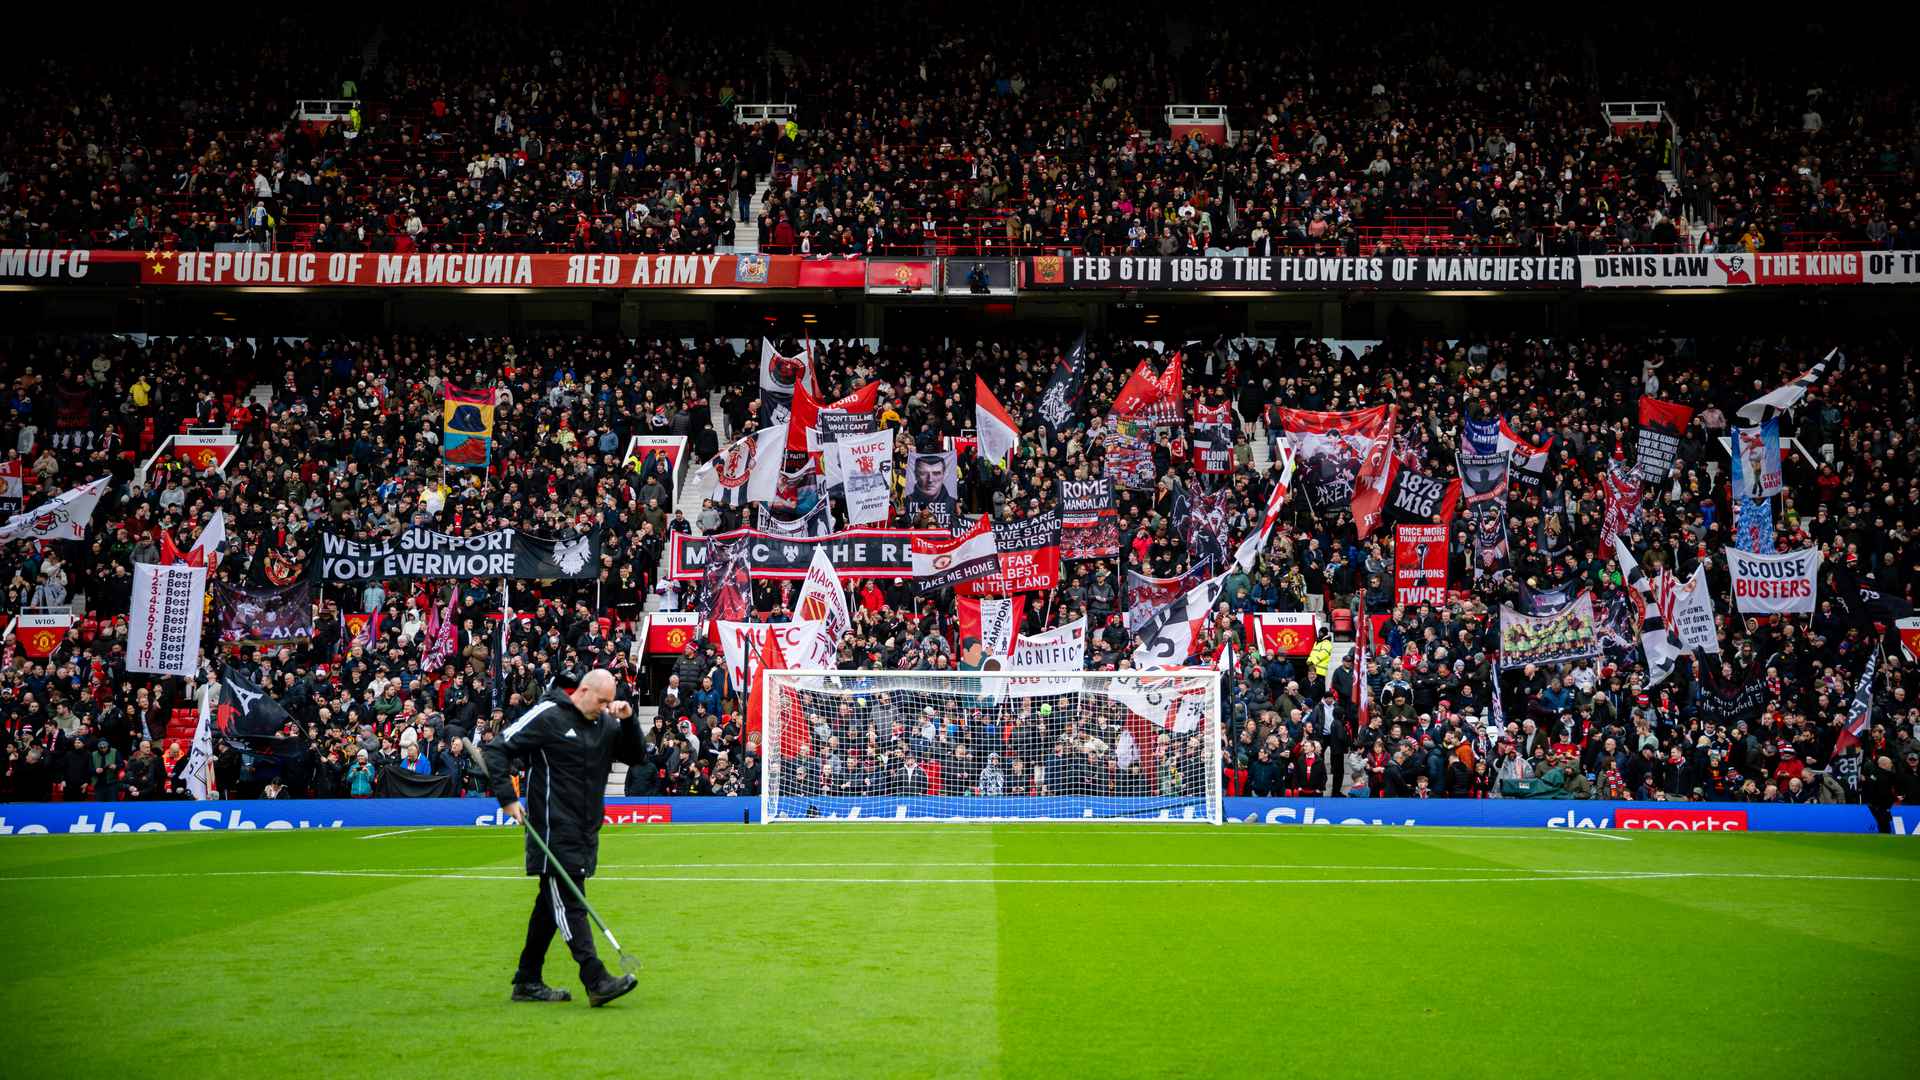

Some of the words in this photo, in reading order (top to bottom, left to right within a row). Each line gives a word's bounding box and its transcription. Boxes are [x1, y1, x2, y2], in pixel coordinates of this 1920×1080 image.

[0, 249, 89, 278] MUFC
[328, 253, 364, 282] OF
[1073, 257, 1111, 281] FEB
[1120, 257, 1161, 281] 6TH
[1171, 257, 1222, 281] 1958
[1232, 257, 1272, 281] THE
[1280, 257, 1383, 281] FLOWERS
[1392, 257, 1418, 281] OF
[1427, 256, 1576, 281] MANCHESTER
[1595, 256, 1657, 278] DENIS
[1663, 256, 1709, 278] LAW
[1760, 254, 1800, 277] THE
[1806, 254, 1857, 276] KING
[1868, 254, 1894, 275] OF
[851, 442, 886, 456] MUFC
[1206, 461, 1224, 470] HELL
[1062, 479, 1109, 498] ROME
[1401, 470, 1443, 499] 1878
[929, 502, 946, 513] SEE
[1063, 496, 1109, 510] MANDALAY
[1008, 520, 1028, 531] WE
[1030, 511, 1056, 525] ARE
[1001, 528, 1020, 540] WE
[1024, 519, 1062, 535] STAND
[1399, 527, 1422, 536] ONCE
[1424, 527, 1447, 536] MORE
[323, 532, 394, 557] WE'LL
[400, 528, 515, 551] SUPPORT
[322, 558, 374, 579] YOU
[384, 553, 515, 576] EVERMORE
[1009, 555, 1033, 566] FAR
[154, 569, 163, 577] 1.
[168, 570, 192, 579] Best
[1008, 565, 1039, 577] BEST
[1399, 569, 1444, 579] CHAMPIONS
[1738, 559, 1805, 578] SCOUSE
[919, 577, 945, 591] TAKE
[947, 570, 963, 581] ME
[964, 560, 995, 577] HOME
[152, 577, 162, 586] 2.
[167, 579, 191, 588] Best
[972, 582, 984, 592] IN
[989, 580, 1013, 591] THE
[1017, 576, 1050, 589] LAND
[1736, 578, 1811, 598] BUSTERS
[151, 586, 160, 595] 3.
[166, 588, 190, 597] Best
[1398, 587, 1445, 604] TWICE
[150, 595, 160, 604] 4.
[165, 597, 190, 606] Best
[149, 604, 159, 613] 5.
[164, 606, 189, 615] Best
[148, 614, 158, 623] 6.
[163, 615, 188, 624] Best
[148, 623, 157, 631] 7.
[162, 624, 186, 633] Best
[146, 632, 156, 641] 8.
[161, 633, 186, 642] Best
[145, 641, 155, 650] 9.
[160, 642, 185, 651] Best
[139, 650, 154, 659] 10.
[160, 651, 184, 660] Best
[138, 659, 154, 668] 11.
[159, 660, 183, 670] Best
